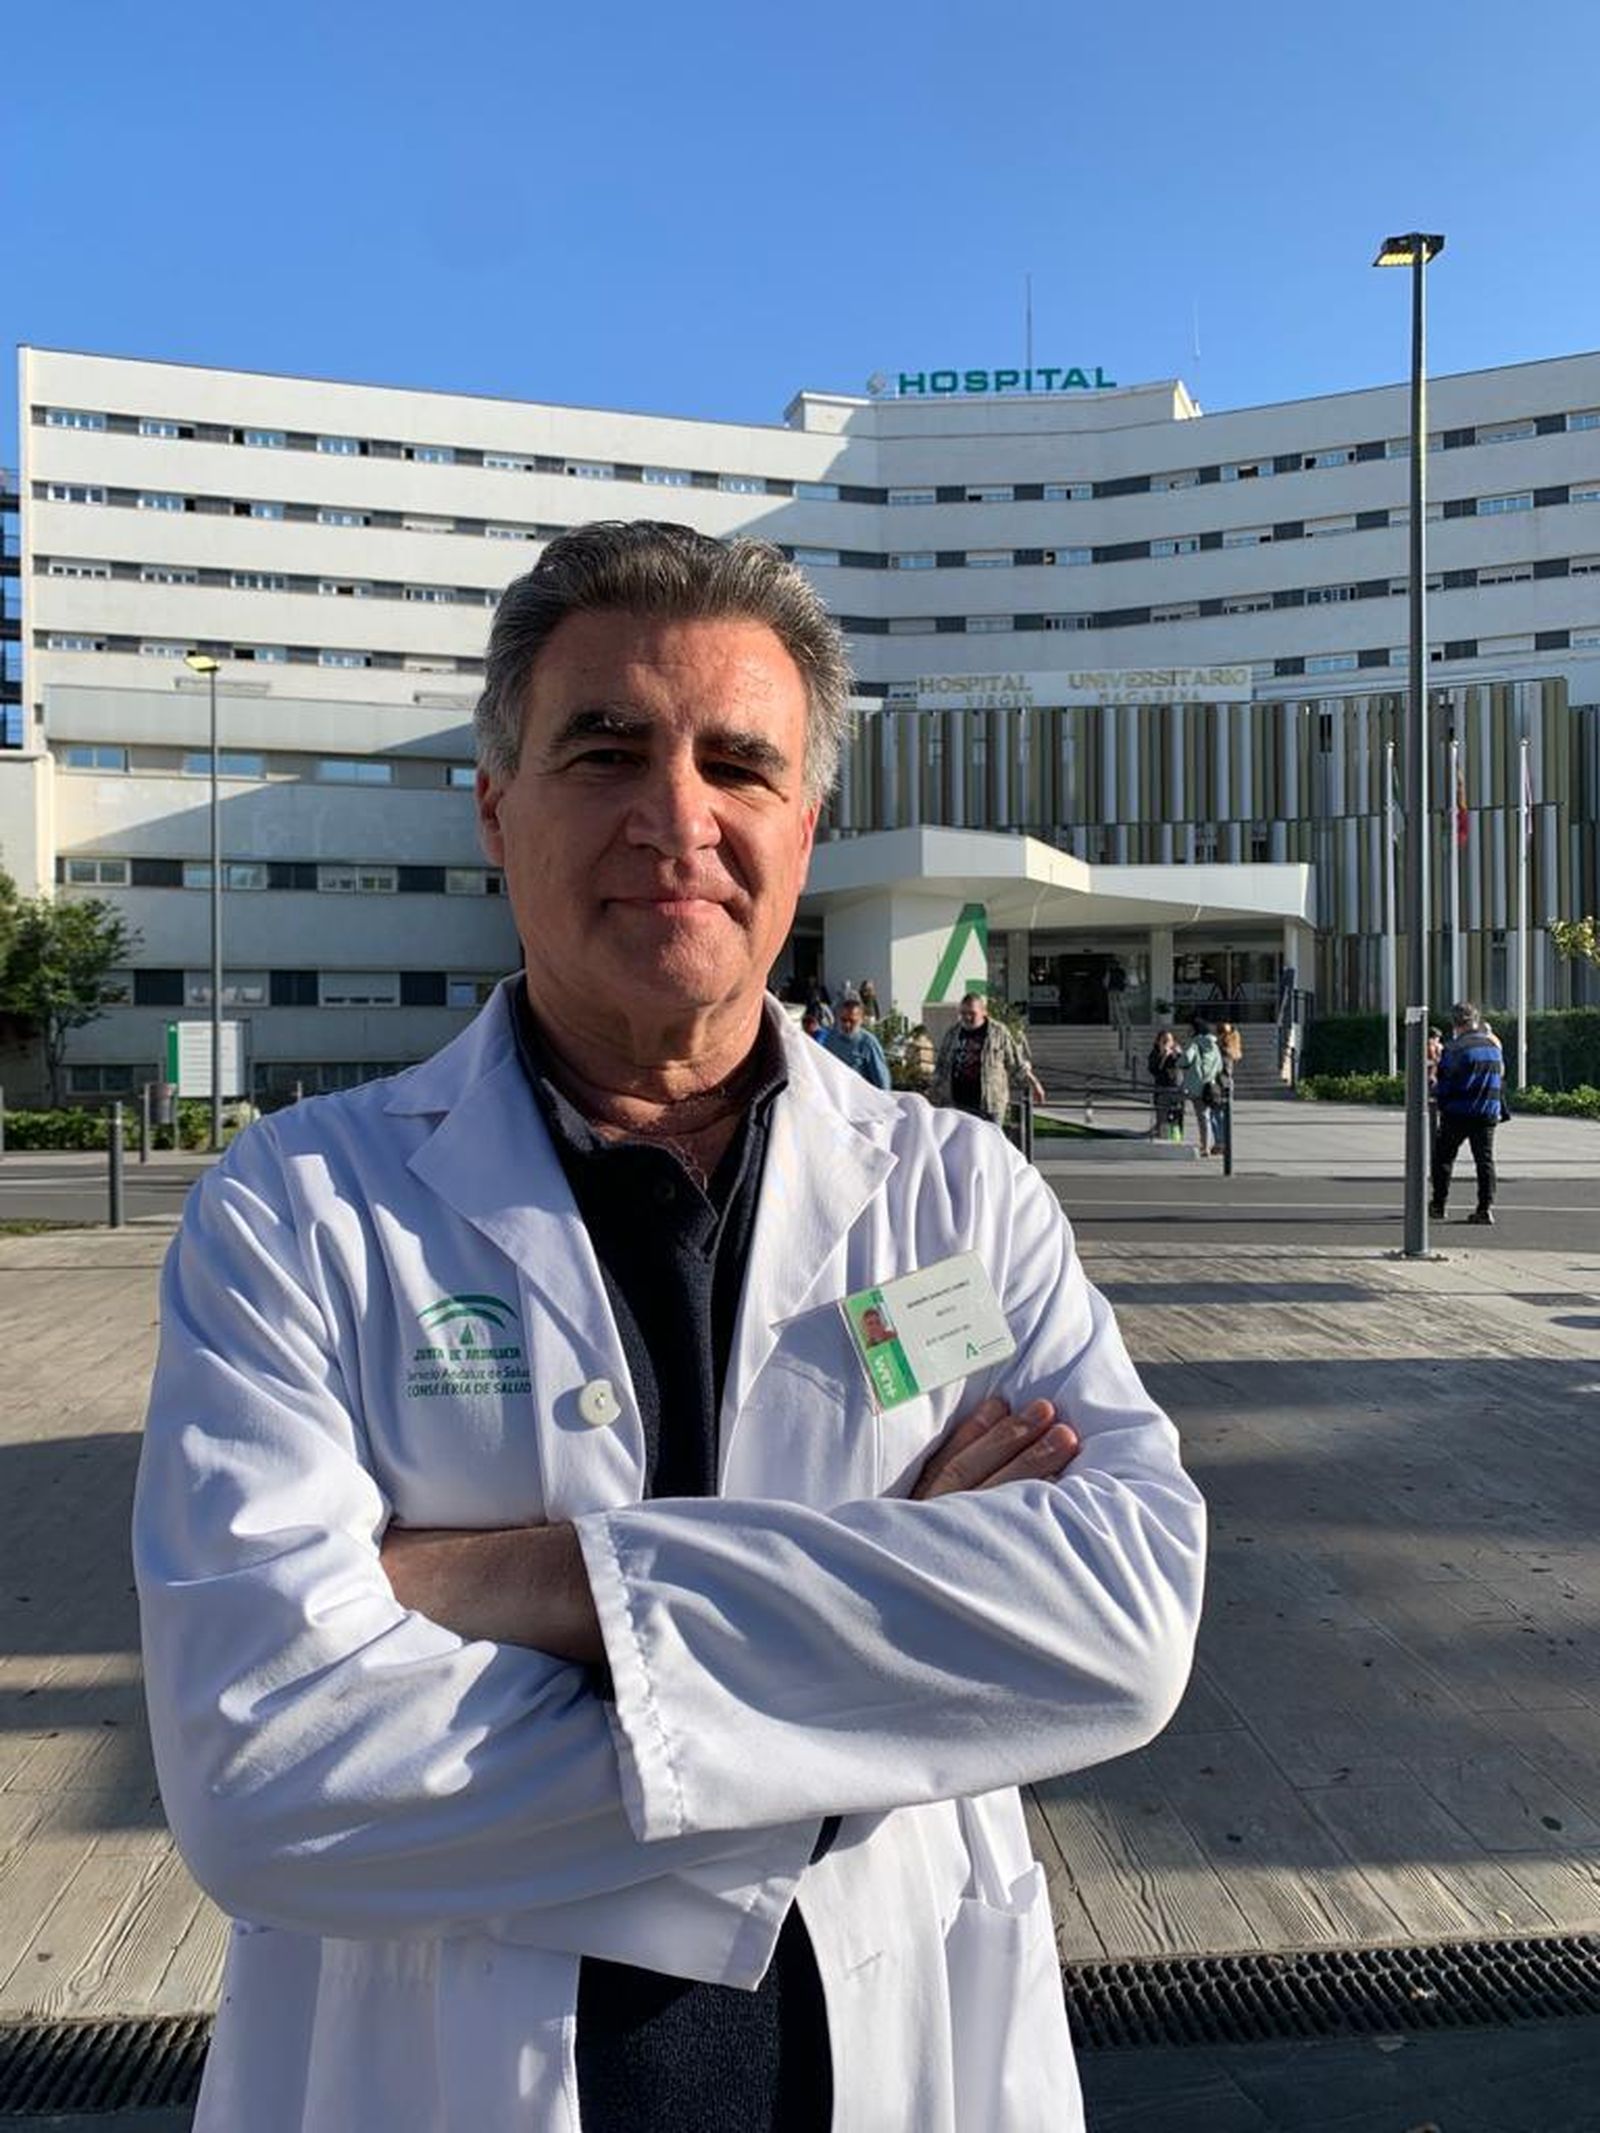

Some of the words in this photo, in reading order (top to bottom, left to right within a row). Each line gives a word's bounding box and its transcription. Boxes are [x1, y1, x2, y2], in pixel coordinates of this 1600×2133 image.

[899, 366, 1118, 395] HOSPITAL
[918, 673, 1033, 695] HOSPITAL
[1068, 668, 1249, 690] UNIVERSITARIO
[473, 1382, 490, 1395] DE
[493, 1381, 532, 1395] SALUD
